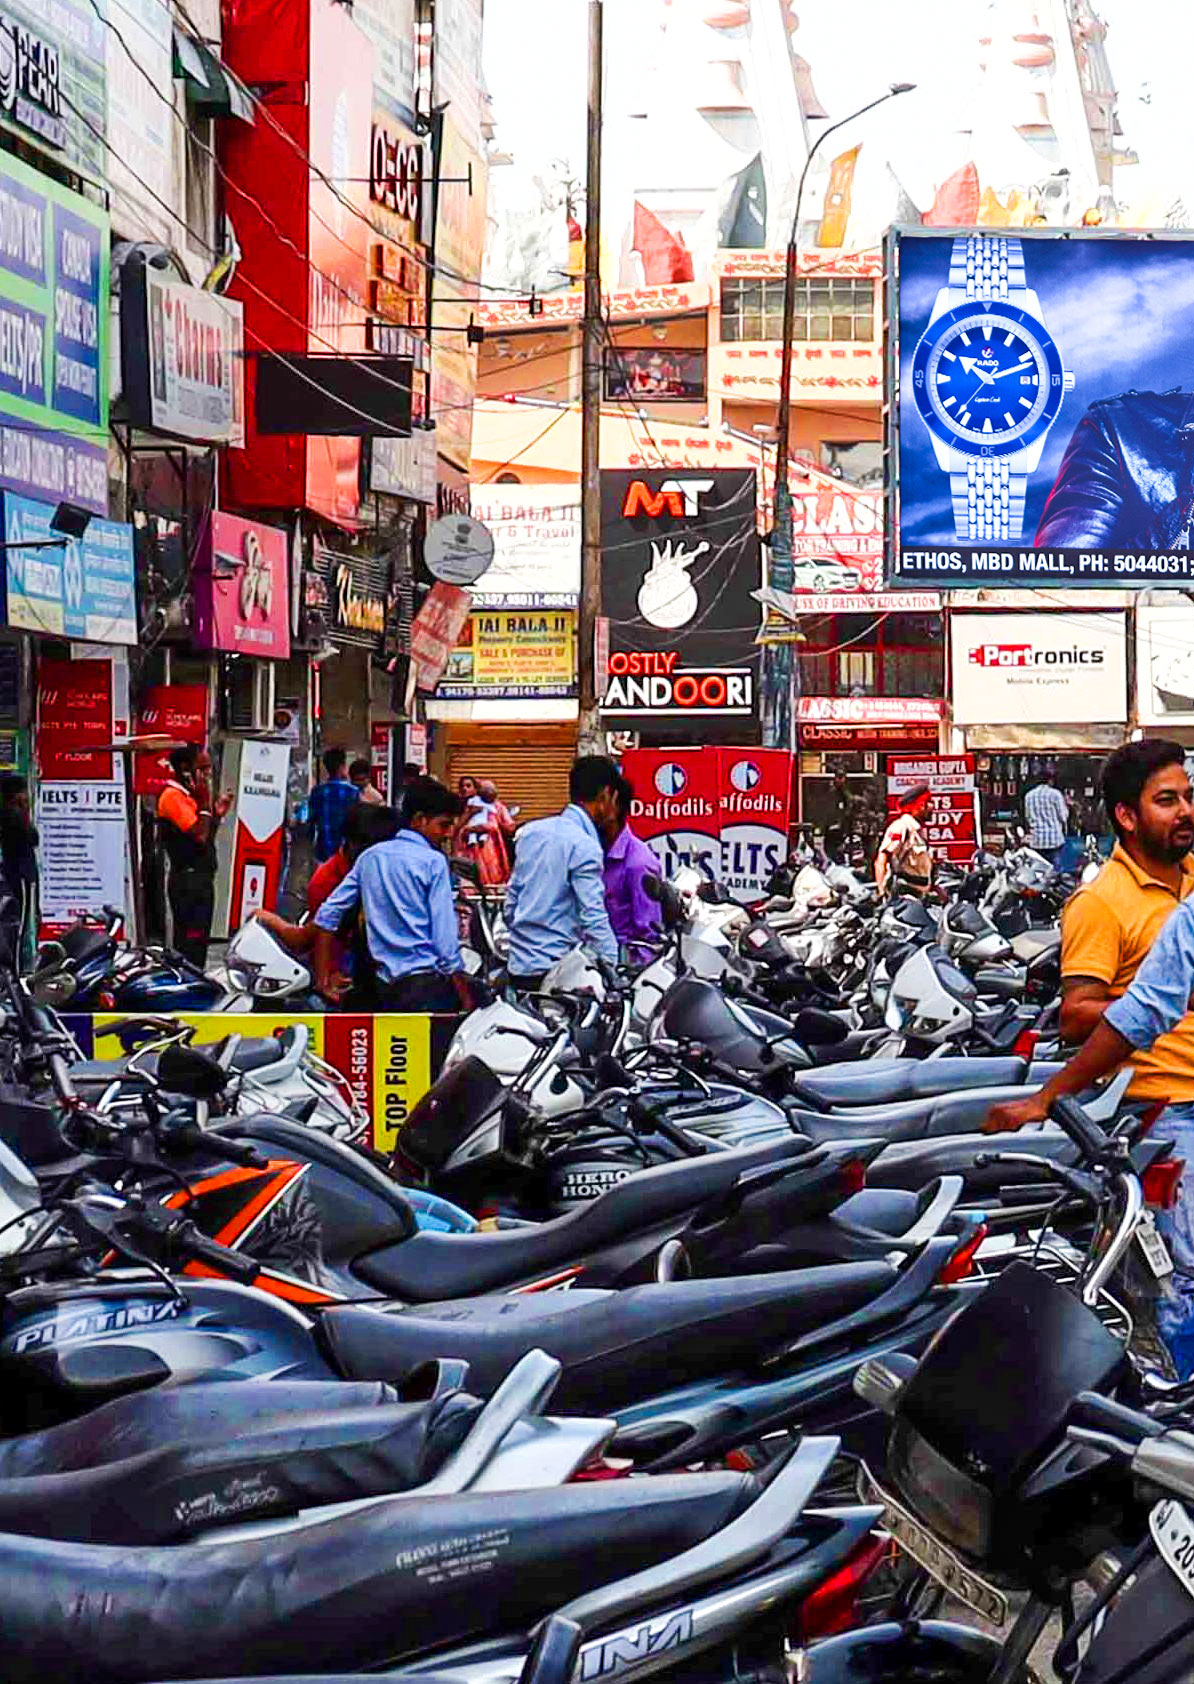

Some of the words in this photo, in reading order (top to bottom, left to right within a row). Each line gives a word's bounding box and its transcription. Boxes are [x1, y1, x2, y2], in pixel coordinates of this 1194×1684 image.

[975, 359, 999, 367] RADO
[624, 480, 715, 517] MT
[501, 505, 552, 521] BALA
[902, 553, 966, 573] ETHOS,
[972, 553, 1014, 571] MBD
[1018, 554, 1074, 574] MALL,
[1079, 555, 1109, 572] PH:
[832, 598, 876, 609] DRIVING
[879, 597, 936, 609] EDUCATION
[507, 617, 548, 632] BALA
[608, 652, 678, 674] OSTLY
[983, 645, 1105, 666] Portronics
[799, 700, 864, 718] LASSIC
[939, 760, 967, 774] GUPTA
[43, 791, 77, 804] IELTS
[96, 790, 123, 804] PTE
[719, 792, 783, 812] affodils
[630, 798, 714, 820] Daffodils
[720, 841, 780, 875] ELTS
[722, 877, 767, 891] ADEMY
[385, 1035, 408, 1085] Floor
[385, 1093, 408, 1133] TOP
[567, 1170, 631, 1185] HERO
[562, 1185, 611, 1198] HON
[12, 1300, 185, 1353] PLATINA
